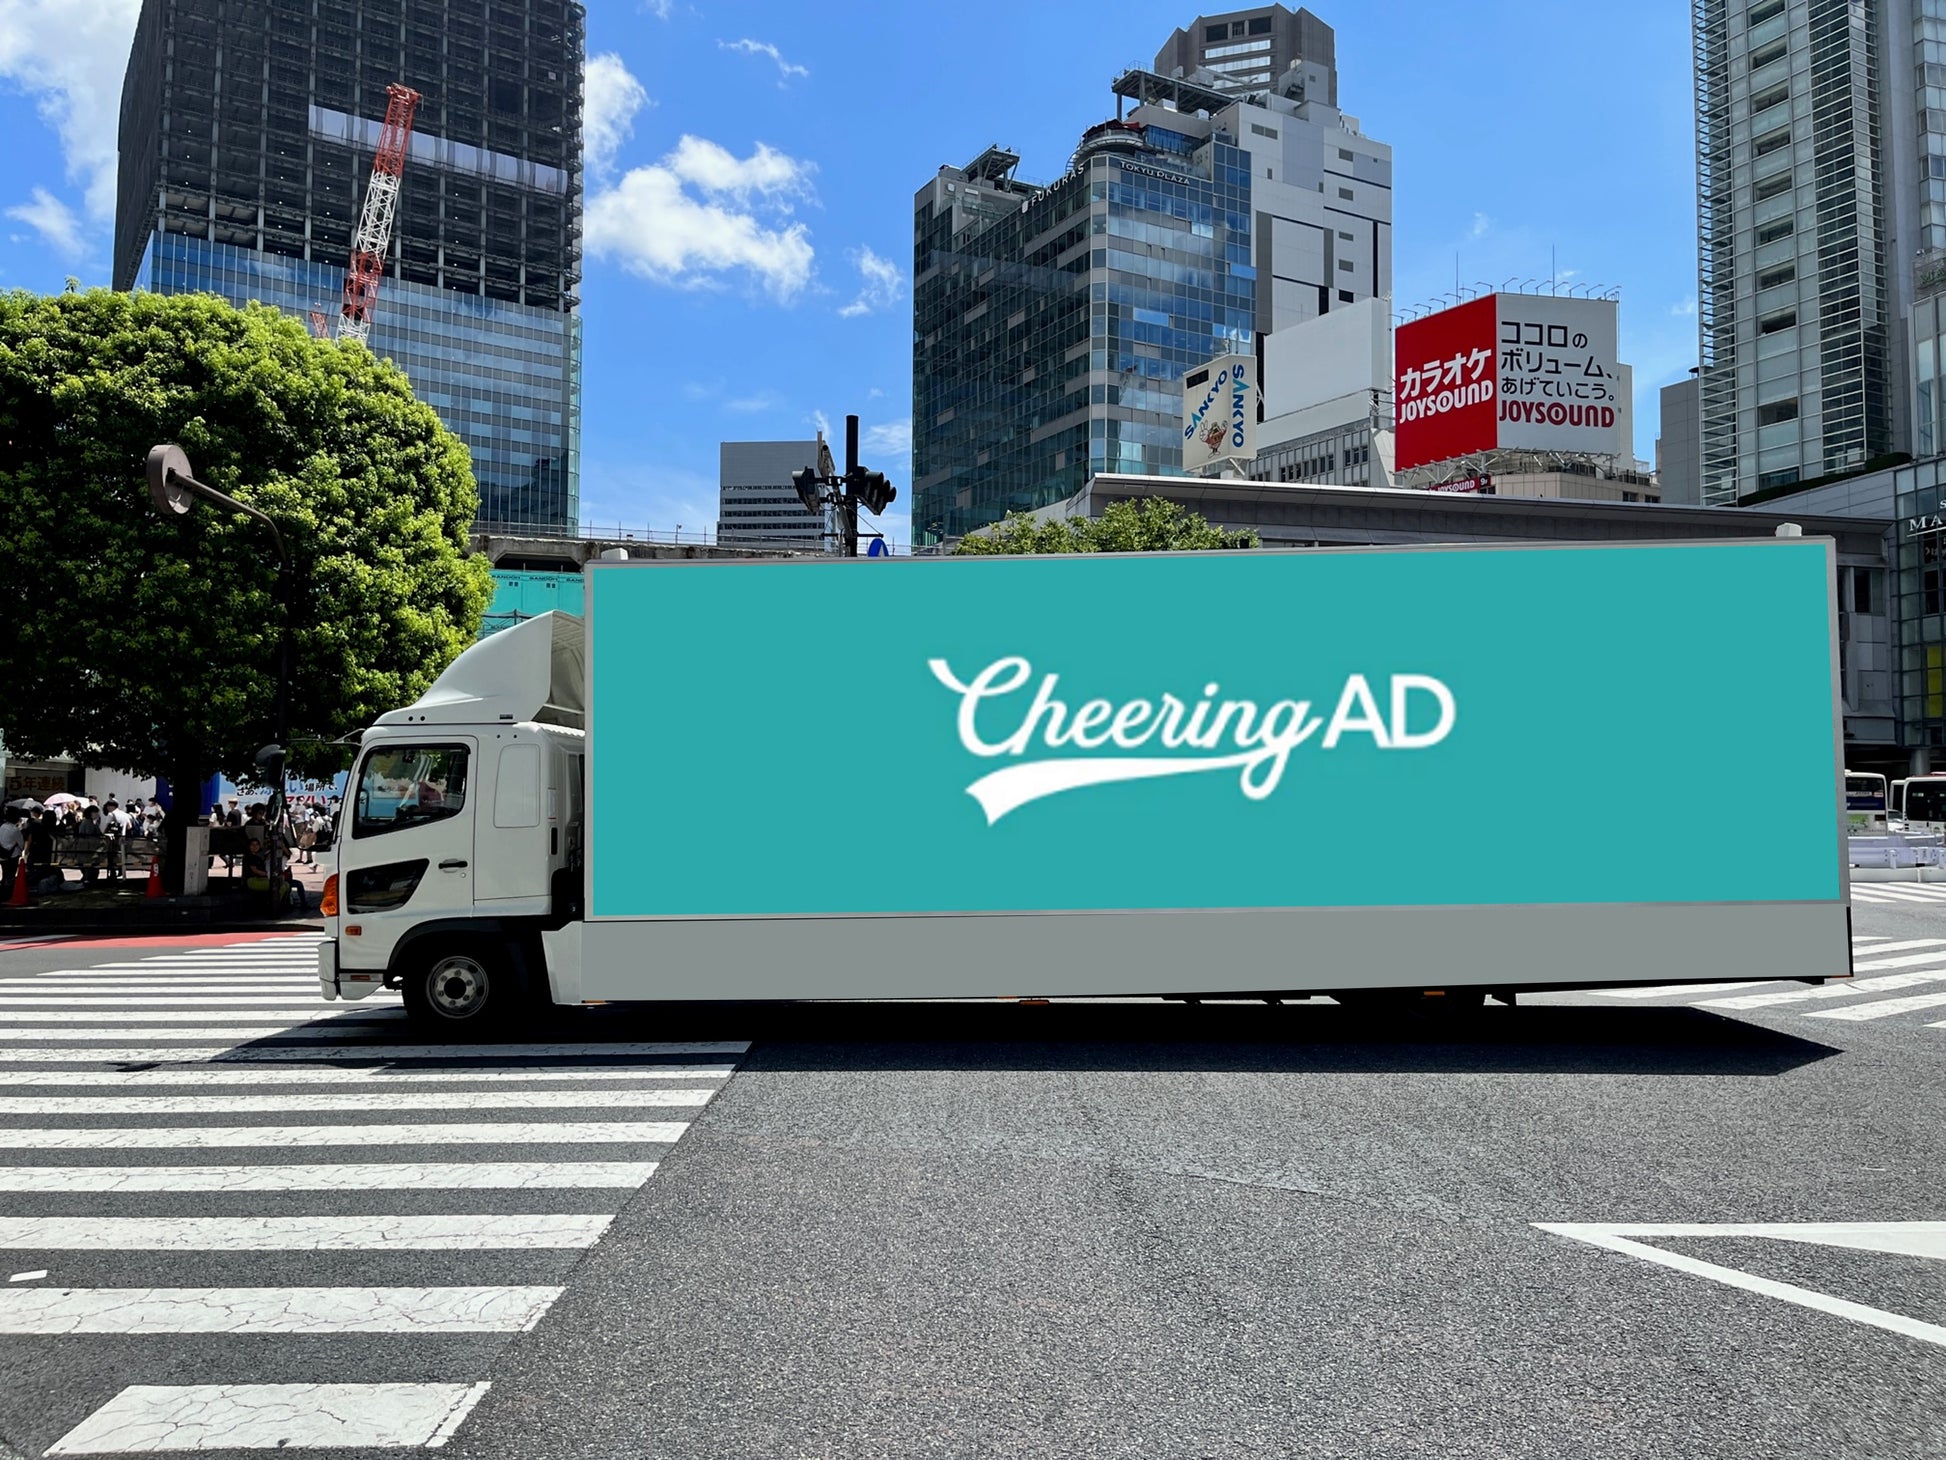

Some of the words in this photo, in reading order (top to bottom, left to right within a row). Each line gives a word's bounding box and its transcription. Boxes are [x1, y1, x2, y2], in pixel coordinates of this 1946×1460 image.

[1031, 164, 1084, 207] FUKURAS
[1120, 160, 1154, 176] TOKYU
[1156, 170, 1190, 185] PLAZA
[1501, 321, 1588, 348] ココロの
[1400, 348, 1491, 400] カラオケ
[1501, 348, 1613, 380] ボリューム、
[1185, 370, 1228, 440] SANKYO
[1232, 364, 1250, 448] SANKYO
[1400, 380, 1493, 424] JOYSOUND
[1501, 376, 1615, 402] あげていこう。
[1499, 400, 1615, 428] JOYSOUND
[928, 656, 1323, 826] Cheering
[1322, 674, 1457, 748] AD
